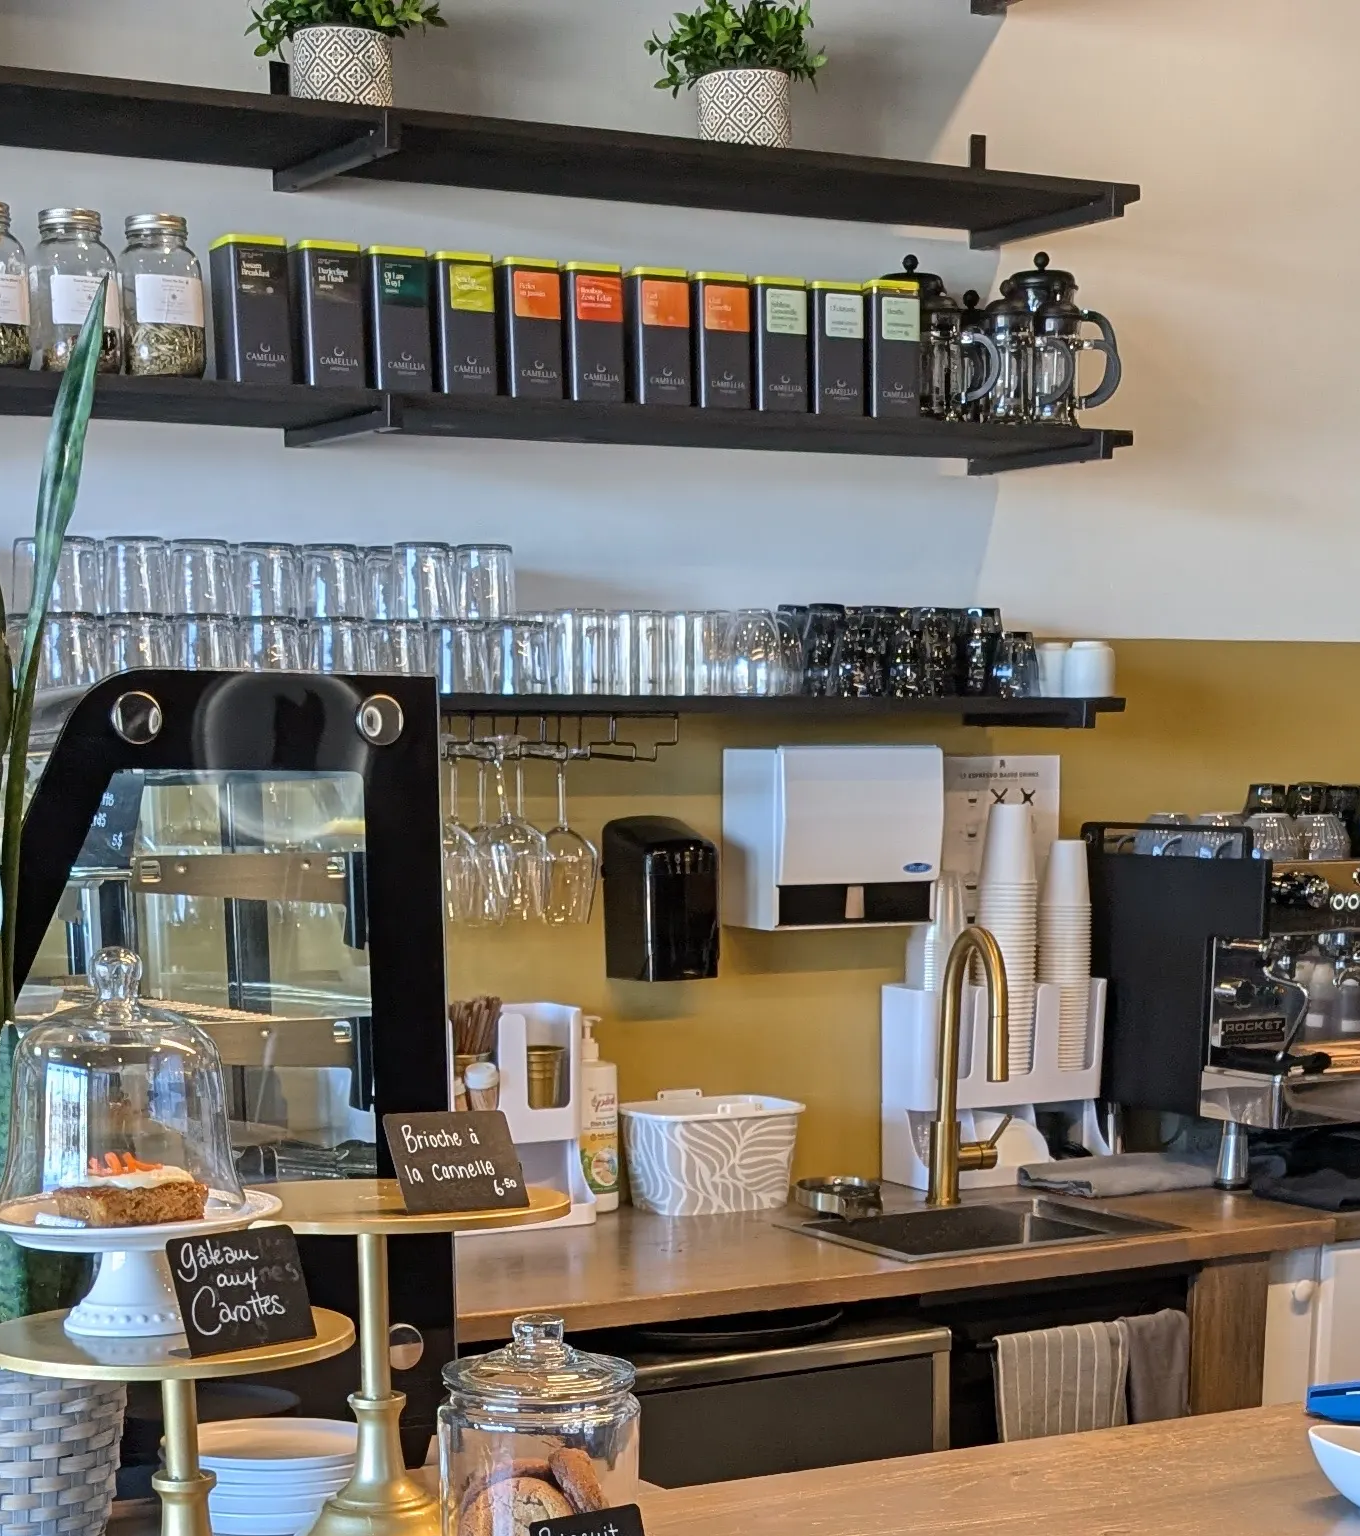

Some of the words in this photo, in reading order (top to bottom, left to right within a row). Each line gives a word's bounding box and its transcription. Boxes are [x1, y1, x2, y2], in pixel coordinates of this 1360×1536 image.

[246, 352, 285, 362] CAMELLIA
[320, 356, 359, 367] CAMELLIA
[388, 361, 426, 371] CAMELLIA
[453, 365, 490, 375] CAMELLIA
[521, 369, 558, 379] CAMELLIA
[583, 373, 620, 383] CAMELLIA
[650, 376, 685, 386] CAMELLIA
[711, 380, 746, 390] CAMELLIA
[768, 383, 803, 393] CAMELLIA
[824, 387, 858, 396] CAMELLIA
[883, 390, 915, 399] CAMELLIA
[1225, 1020, 1283, 1032] ROCKET
[401, 1124, 462, 1154] Brioche
[469, 1128, 480, 1145] à
[404, 1164, 424, 1185] la
[216, 1268, 259, 1291] aux
[191, 1285, 286, 1336] Carottes
